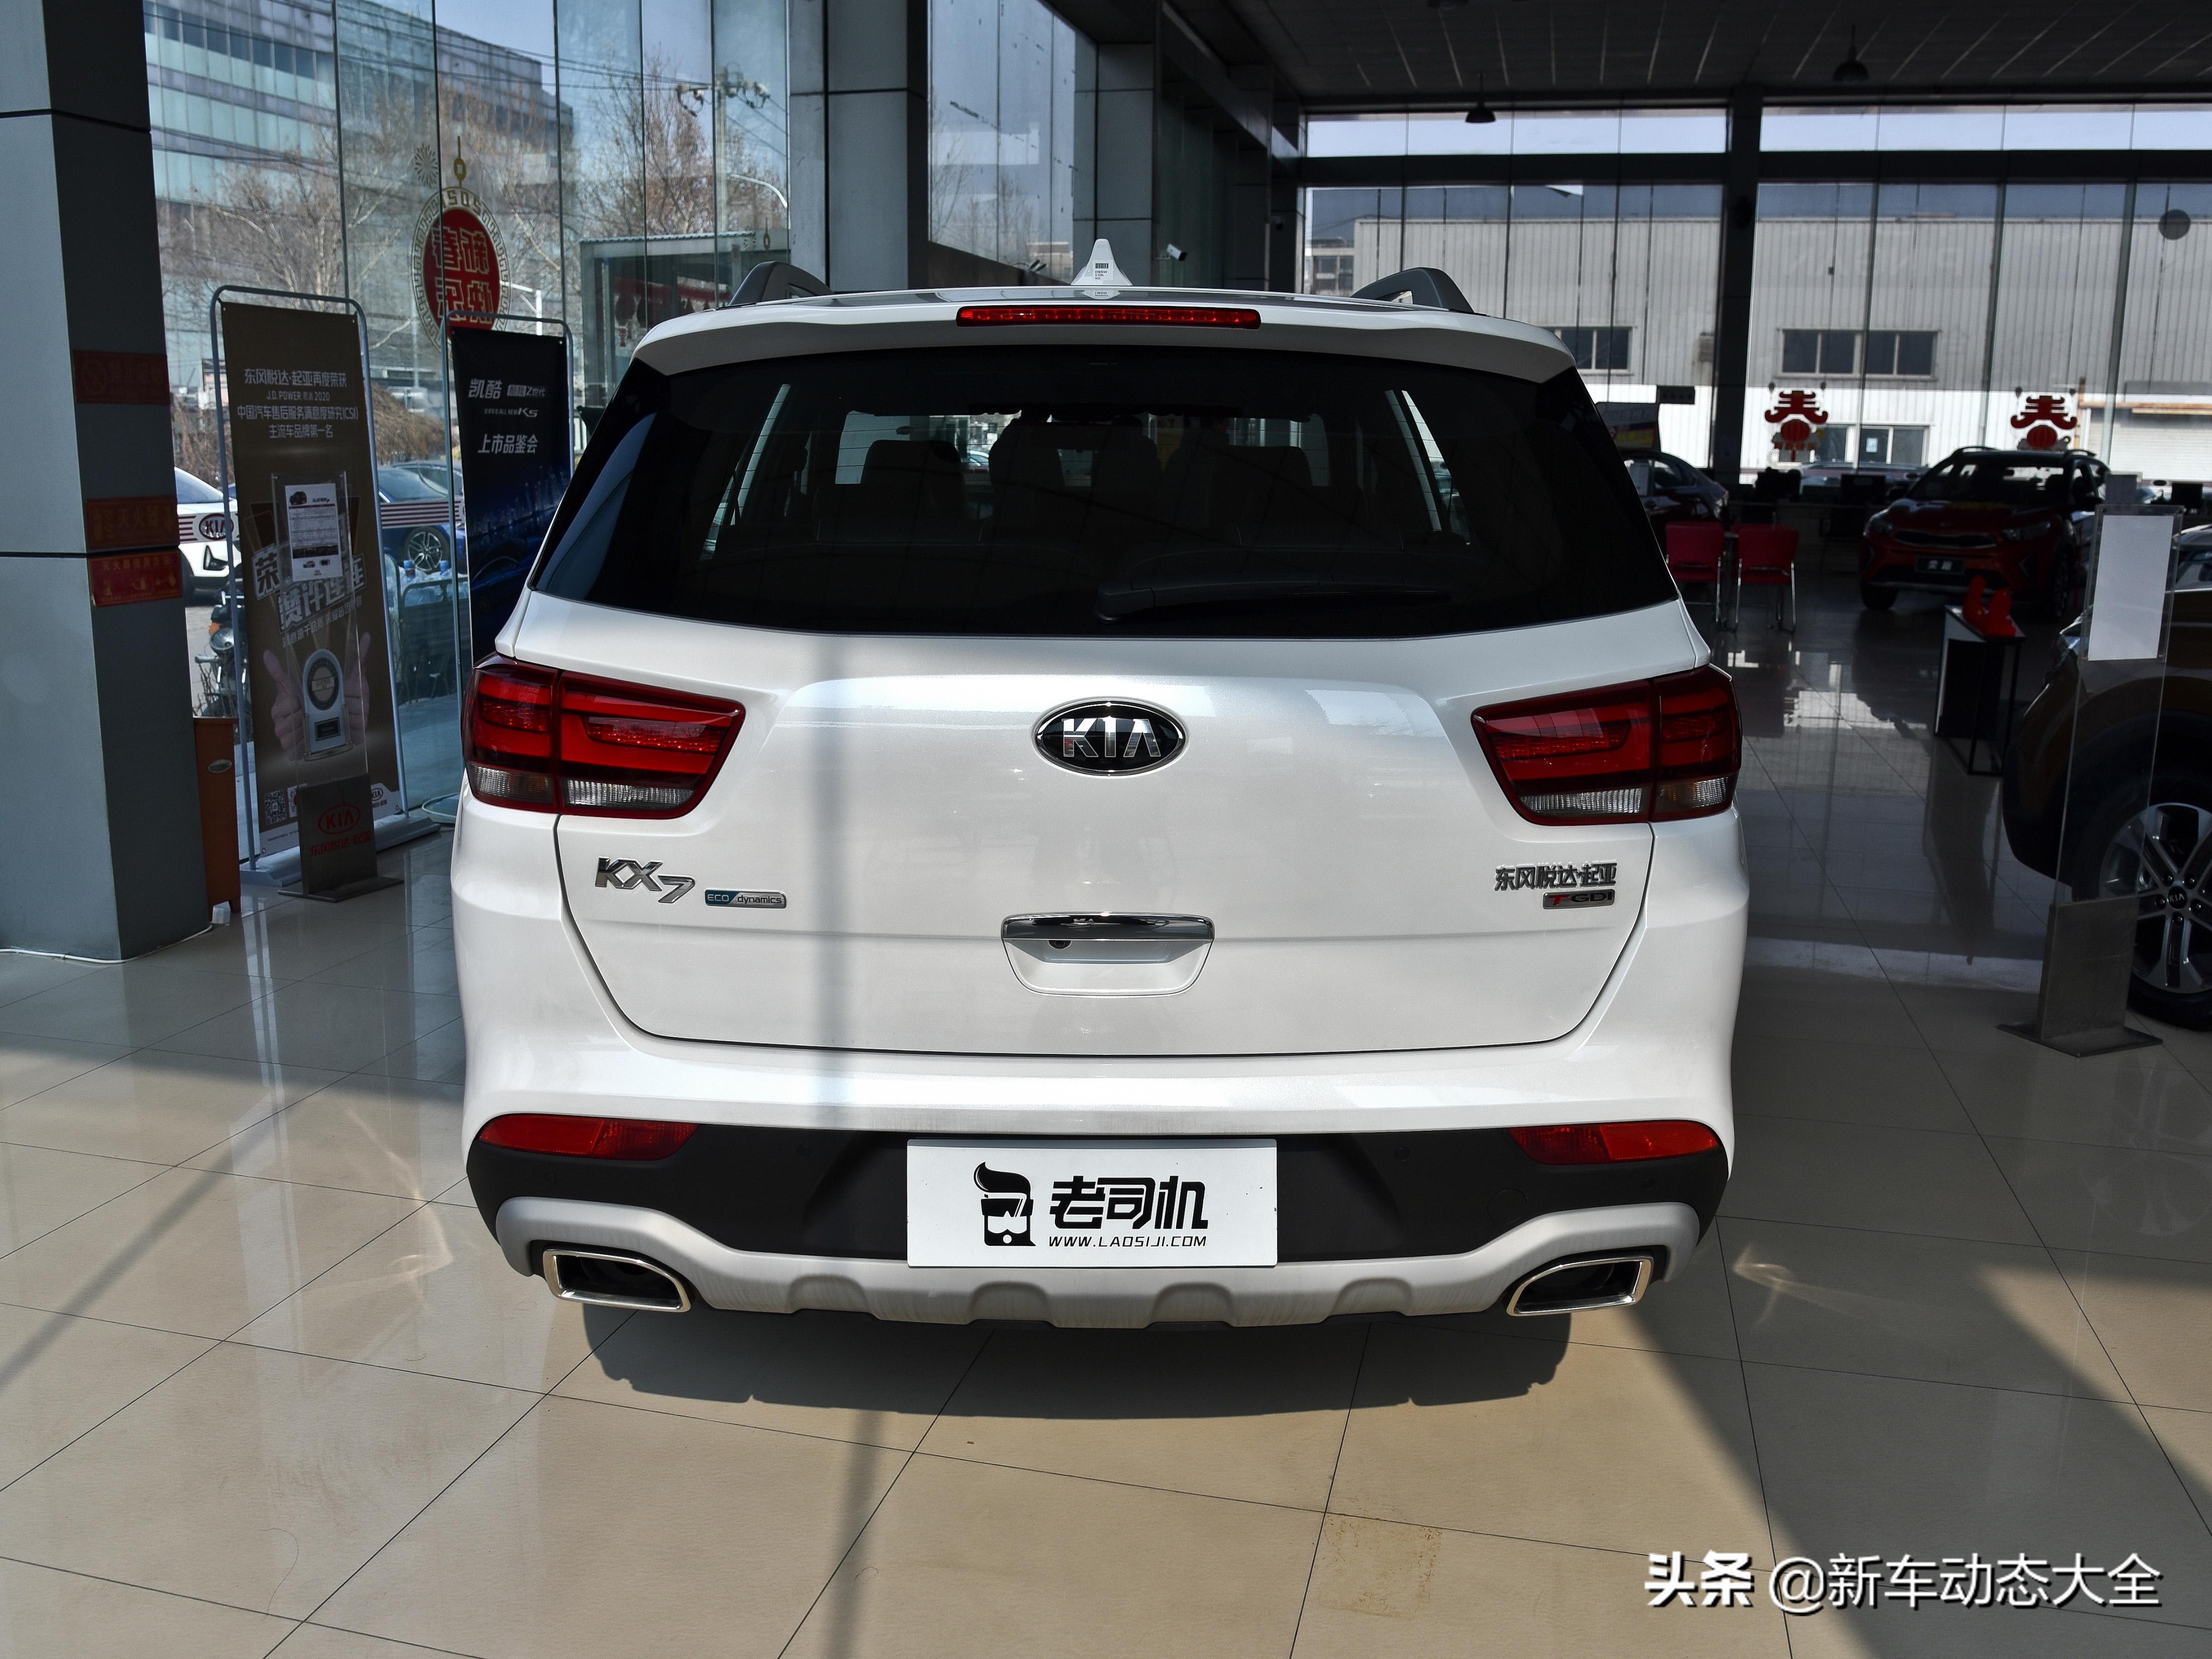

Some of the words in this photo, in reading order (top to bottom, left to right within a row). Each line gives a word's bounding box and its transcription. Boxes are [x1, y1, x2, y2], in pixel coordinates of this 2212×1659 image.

[279, 391, 302, 401] POWER
[314, 392, 330, 402] 2020
[469, 378, 503, 399] 凯酷
[518, 407, 538, 418] K5
[269, 423, 334, 439] 主流车品牌第一名
[477, 433, 538, 454] 上市品鉴会
[1061, 717, 1161, 757] KIA
[325, 809, 355, 829] KIA
[595, 857, 695, 904] KX7
[707, 894, 729, 902] ECO
[737, 895, 782, 904] dynamics
[2169, 893, 2185, 903] KIA
[1049, 1175, 1209, 1230] 老司机
[1049, 1235, 1207, 1247] WWW.LAOSIJI.COM
